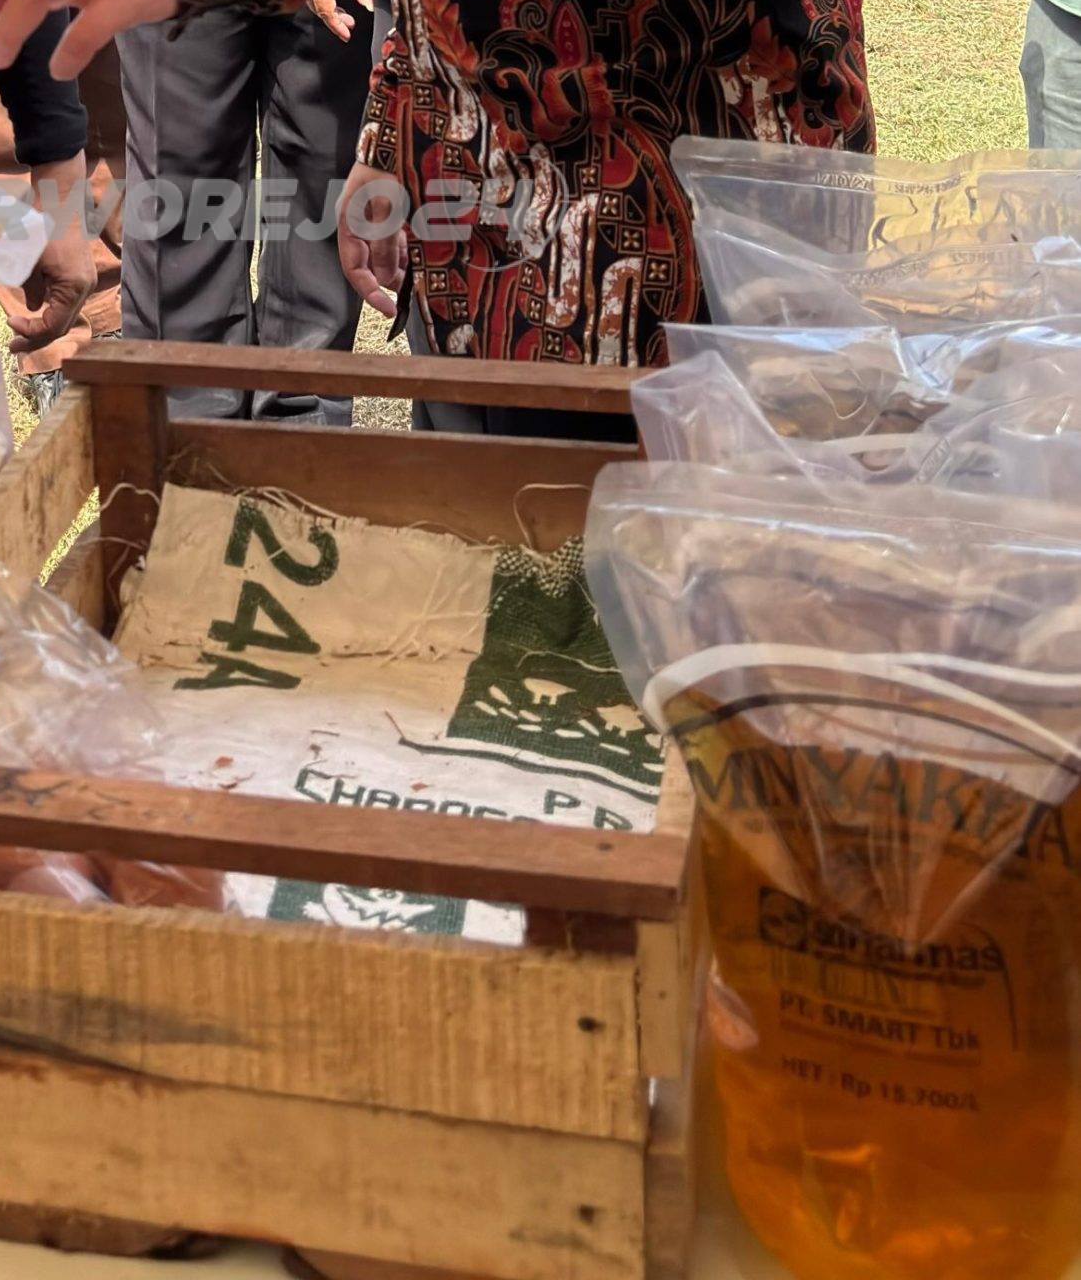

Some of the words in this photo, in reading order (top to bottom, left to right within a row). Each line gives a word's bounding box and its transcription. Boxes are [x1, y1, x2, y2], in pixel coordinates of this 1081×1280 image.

[822, 1003, 920, 1046] SMART
[932, 1025, 981, 1052] Tbk
[840, 1072, 872, 1099] Rp
